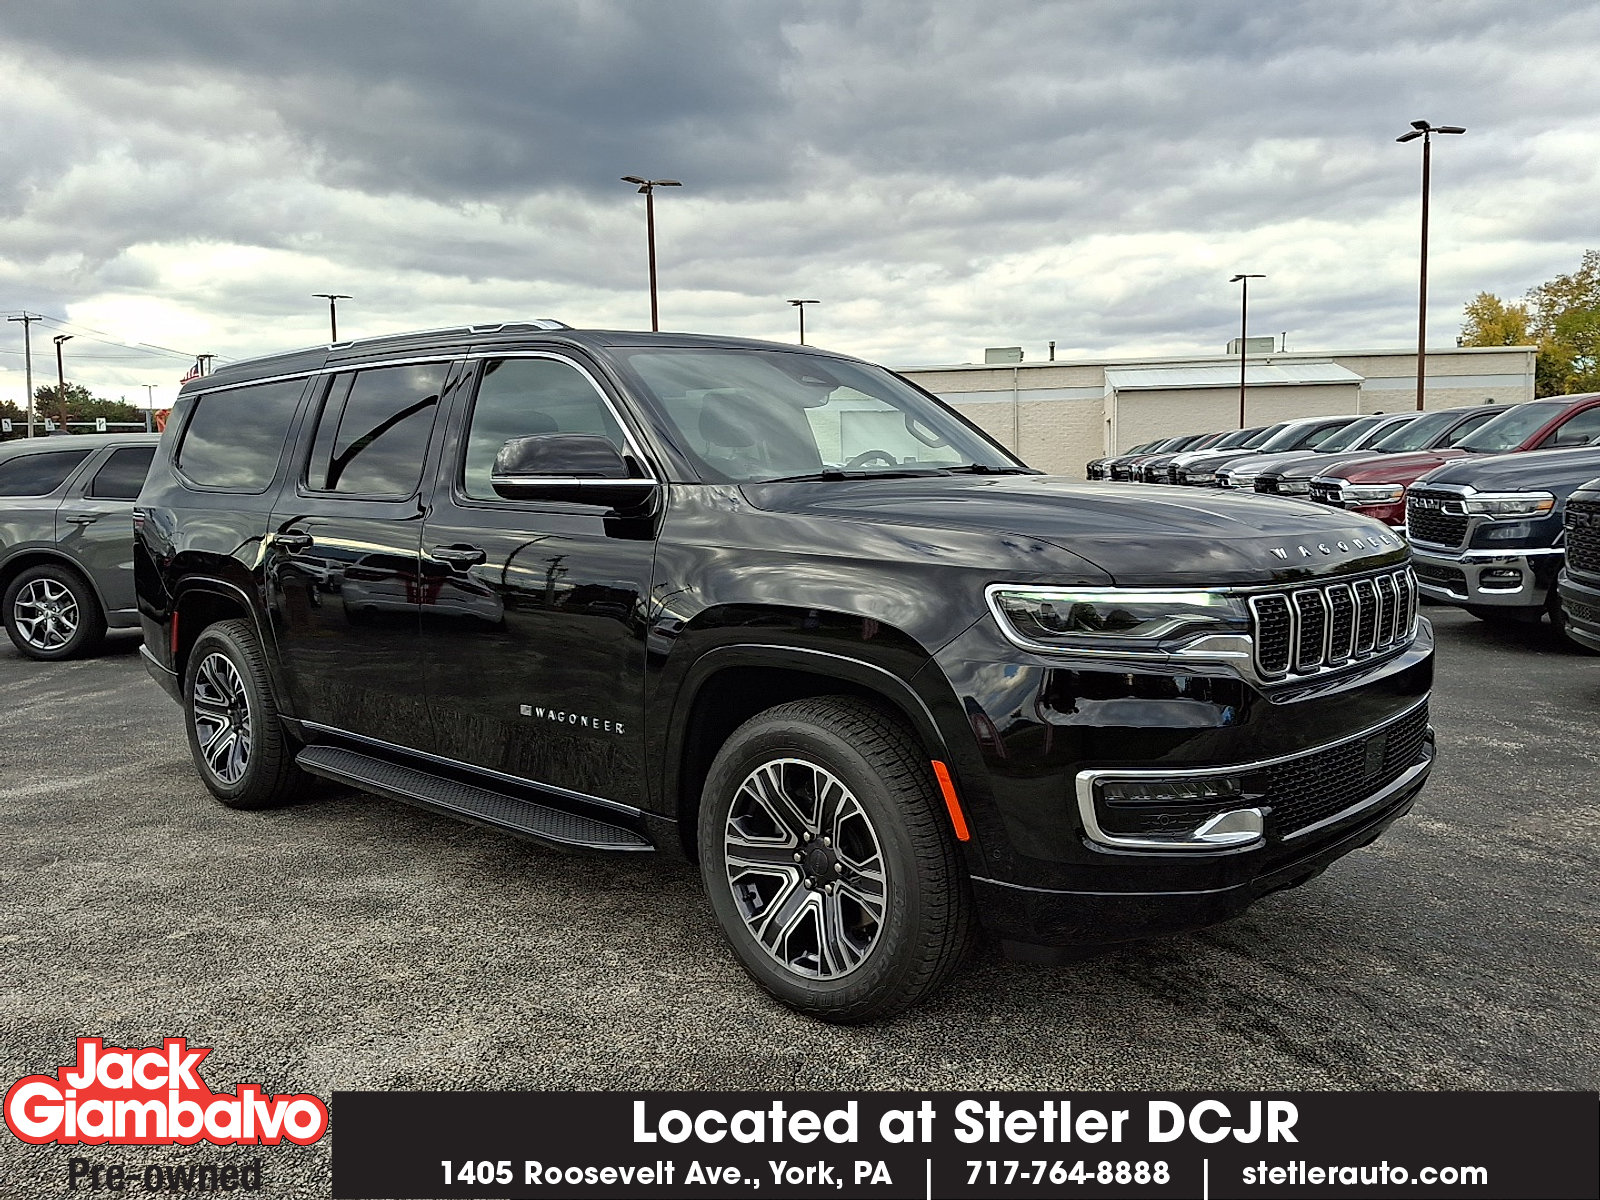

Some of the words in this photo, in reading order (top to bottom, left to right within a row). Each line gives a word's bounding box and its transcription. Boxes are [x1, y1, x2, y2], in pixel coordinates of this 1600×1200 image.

[1409, 496, 1441, 510] RAM
[1270, 533, 1401, 560] WAGONEER
[535, 706, 626, 735] WAGONEER
